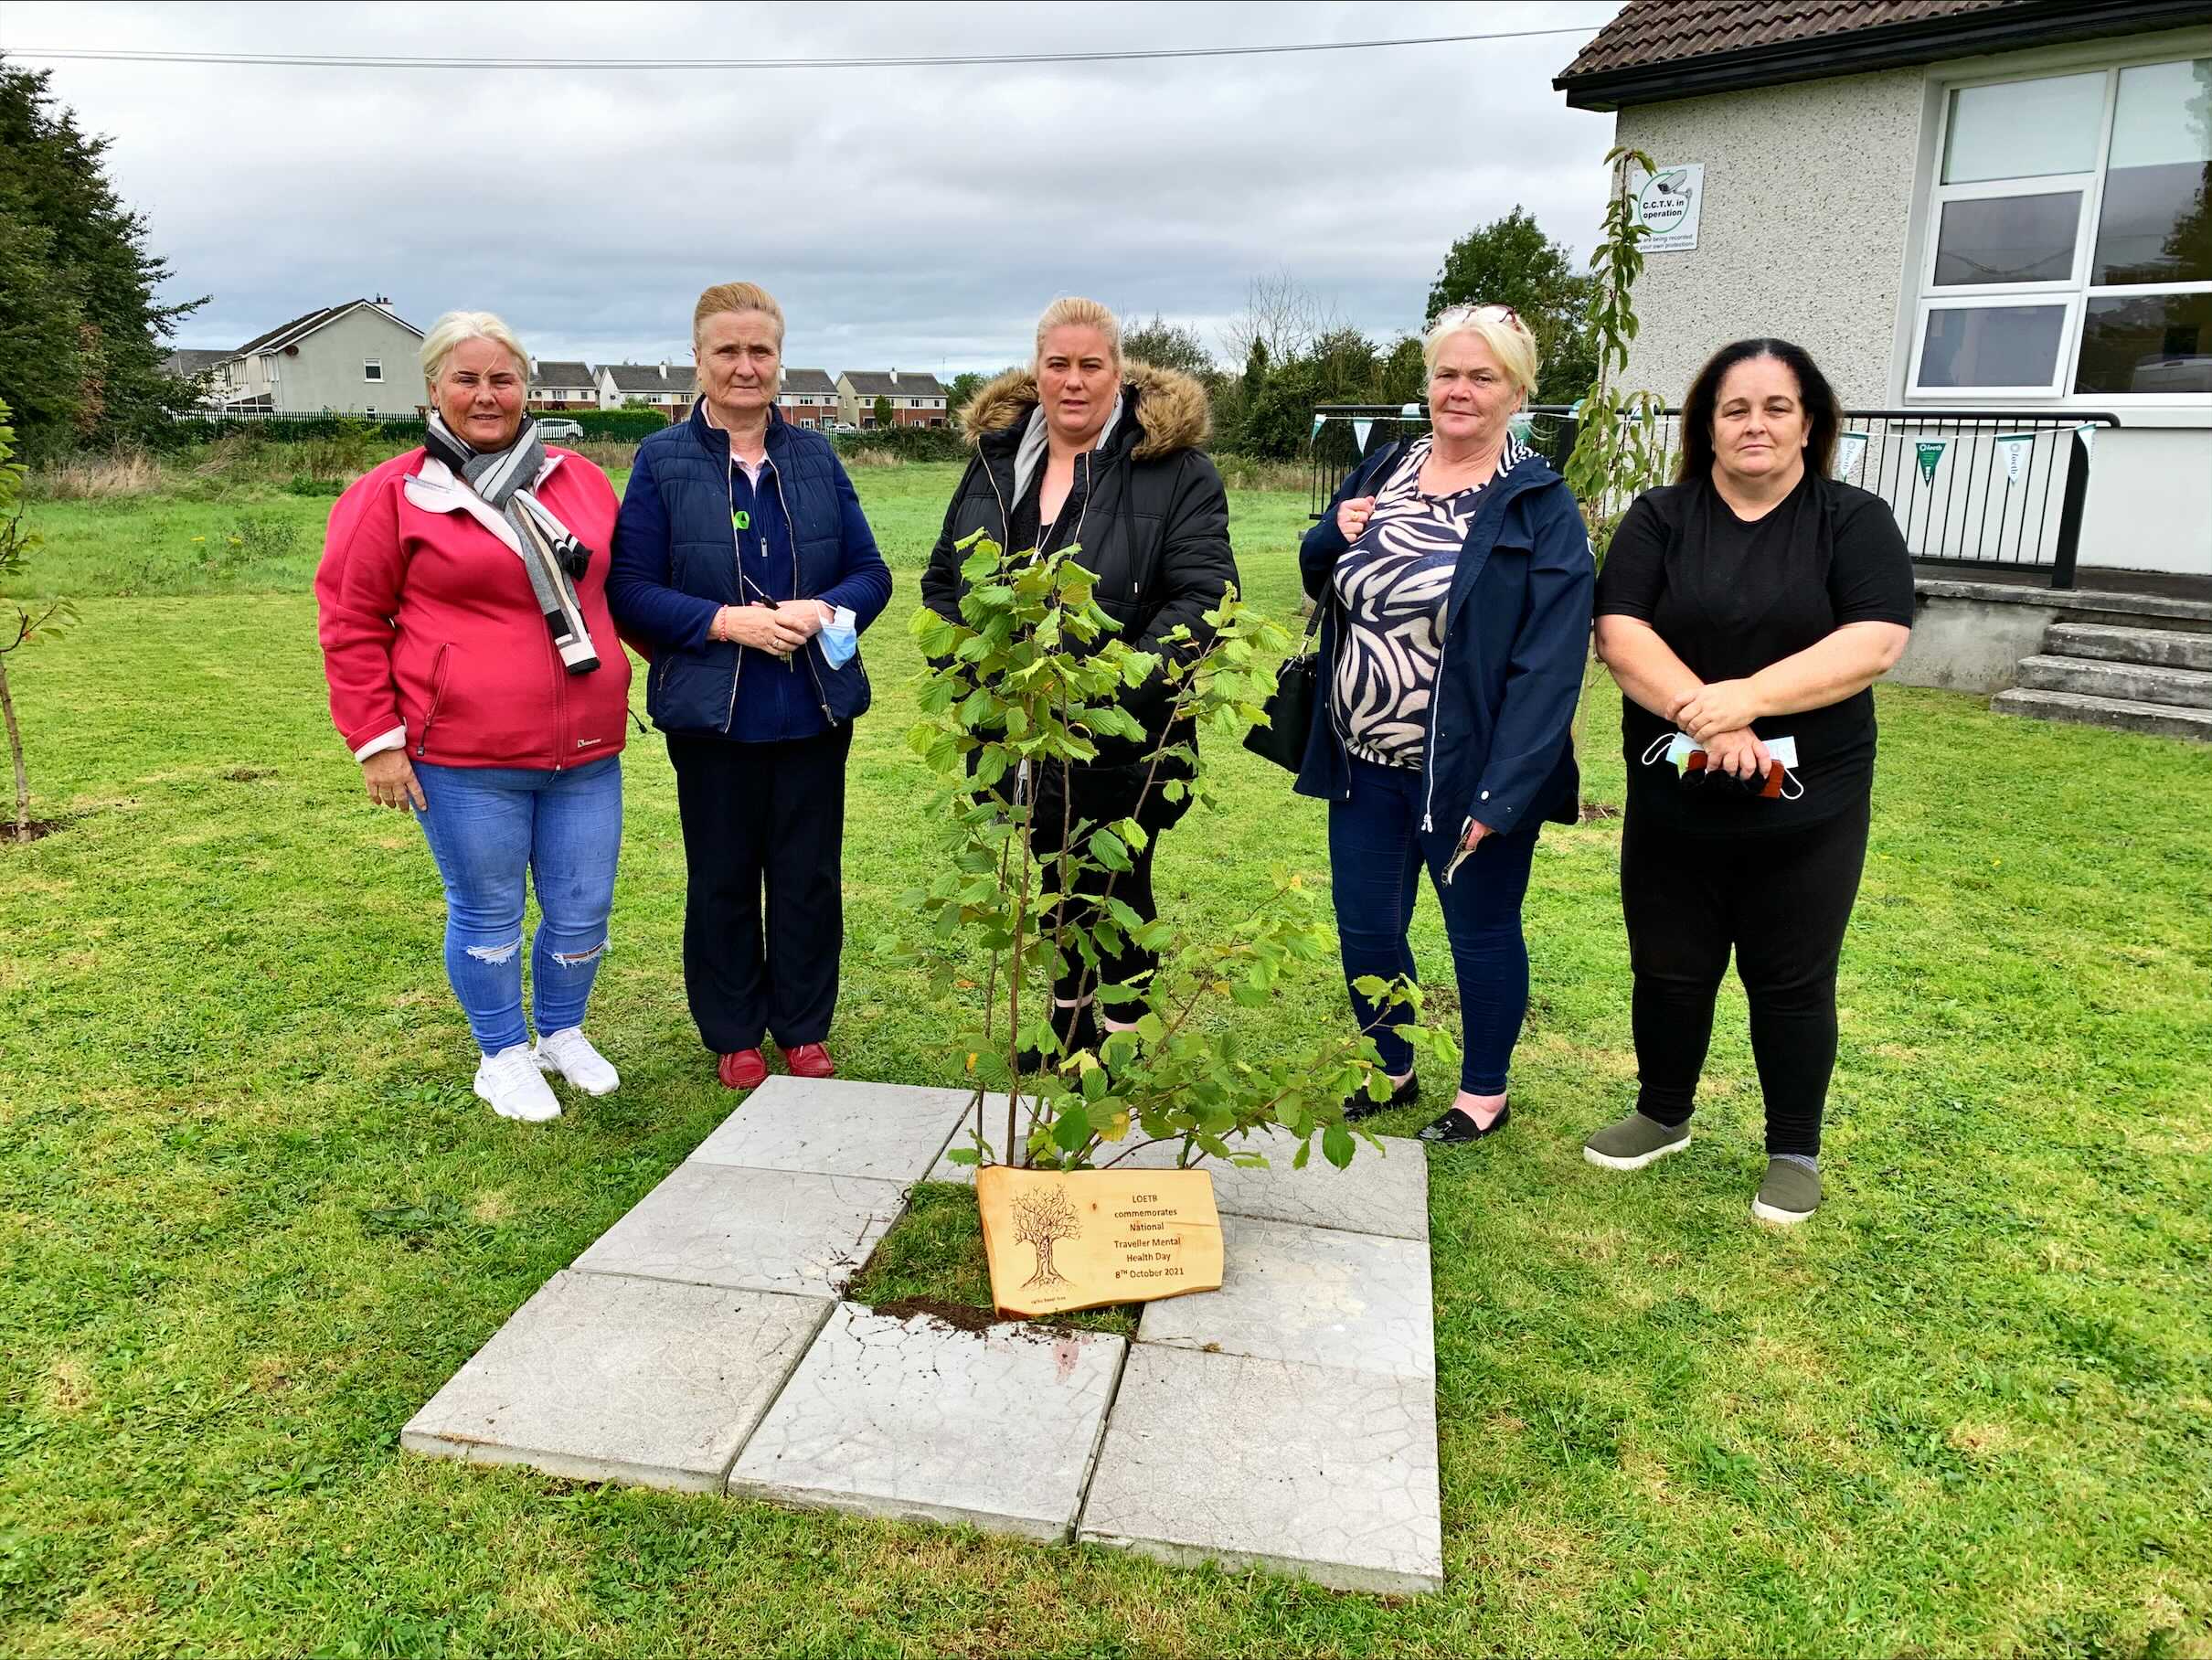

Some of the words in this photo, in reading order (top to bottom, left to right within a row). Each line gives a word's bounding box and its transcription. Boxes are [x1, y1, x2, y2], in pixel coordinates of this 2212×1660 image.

[1643, 200, 1675, 209] C.C.T.V.
[1643, 210, 1682, 219] operation
[1133, 1195, 1157, 1203] LOETB
[1114, 1208, 1177, 1218] commemorates
[1130, 1221, 1164, 1231] National
[1114, 1239, 1150, 1249] Traveller
[1152, 1237, 1181, 1247] Mental
[1126, 1253, 1154, 1262] Health
[1155, 1252, 1171, 1262] Day
[1130, 1269, 1163, 1278] October
[1164, 1268, 1184, 1276] 2021
